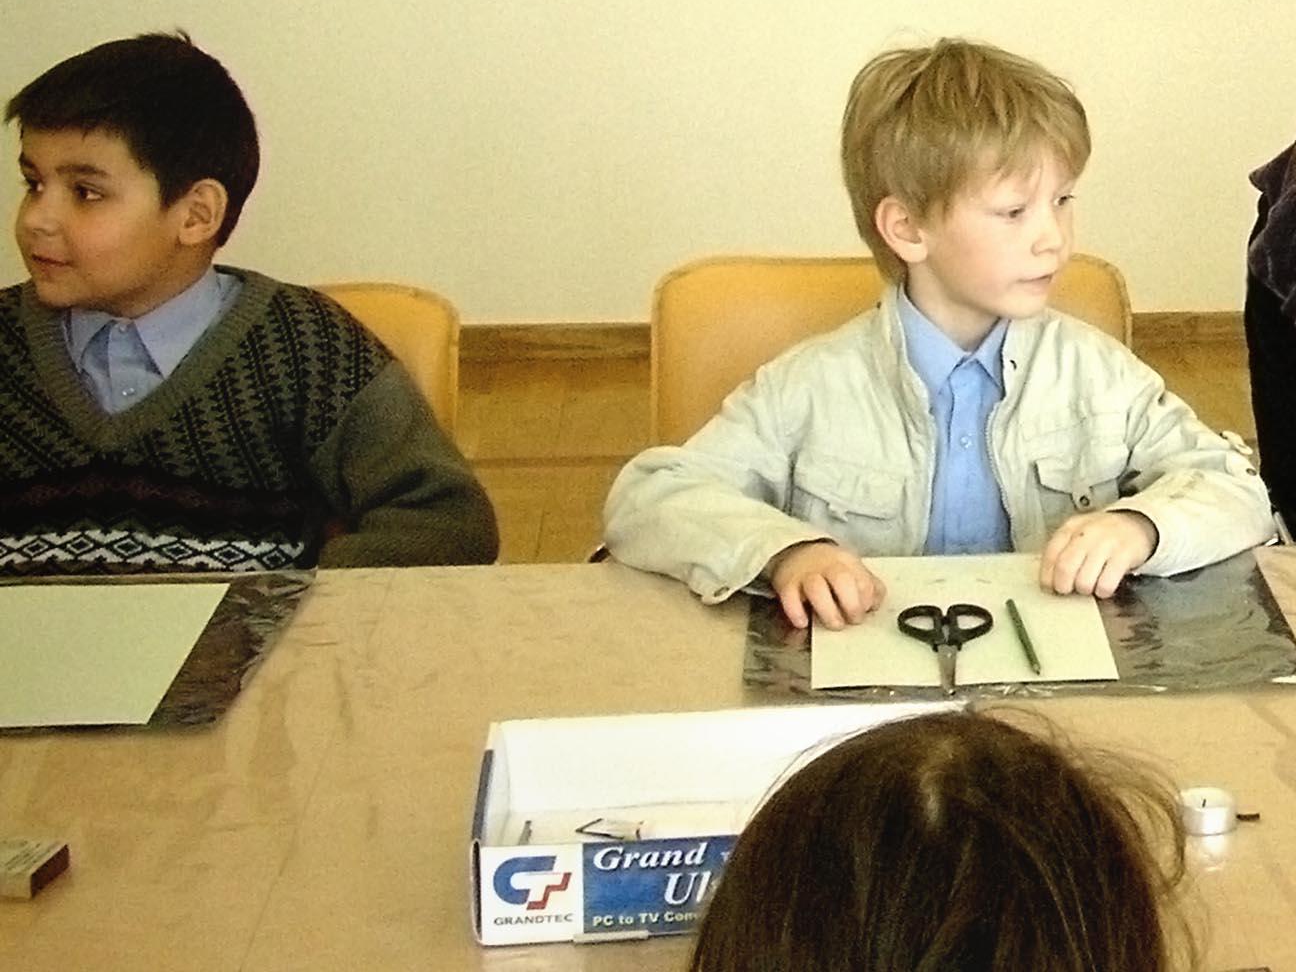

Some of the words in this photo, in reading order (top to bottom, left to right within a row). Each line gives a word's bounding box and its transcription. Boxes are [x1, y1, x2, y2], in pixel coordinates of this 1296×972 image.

[592, 841, 708, 872] Grand
[663, 871, 717, 907] Ul
[493, 913, 574, 927] GRANDTEC
[592, 914, 615, 927] PC
[618, 913, 634, 925] to
[639, 911, 660, 924] TV
